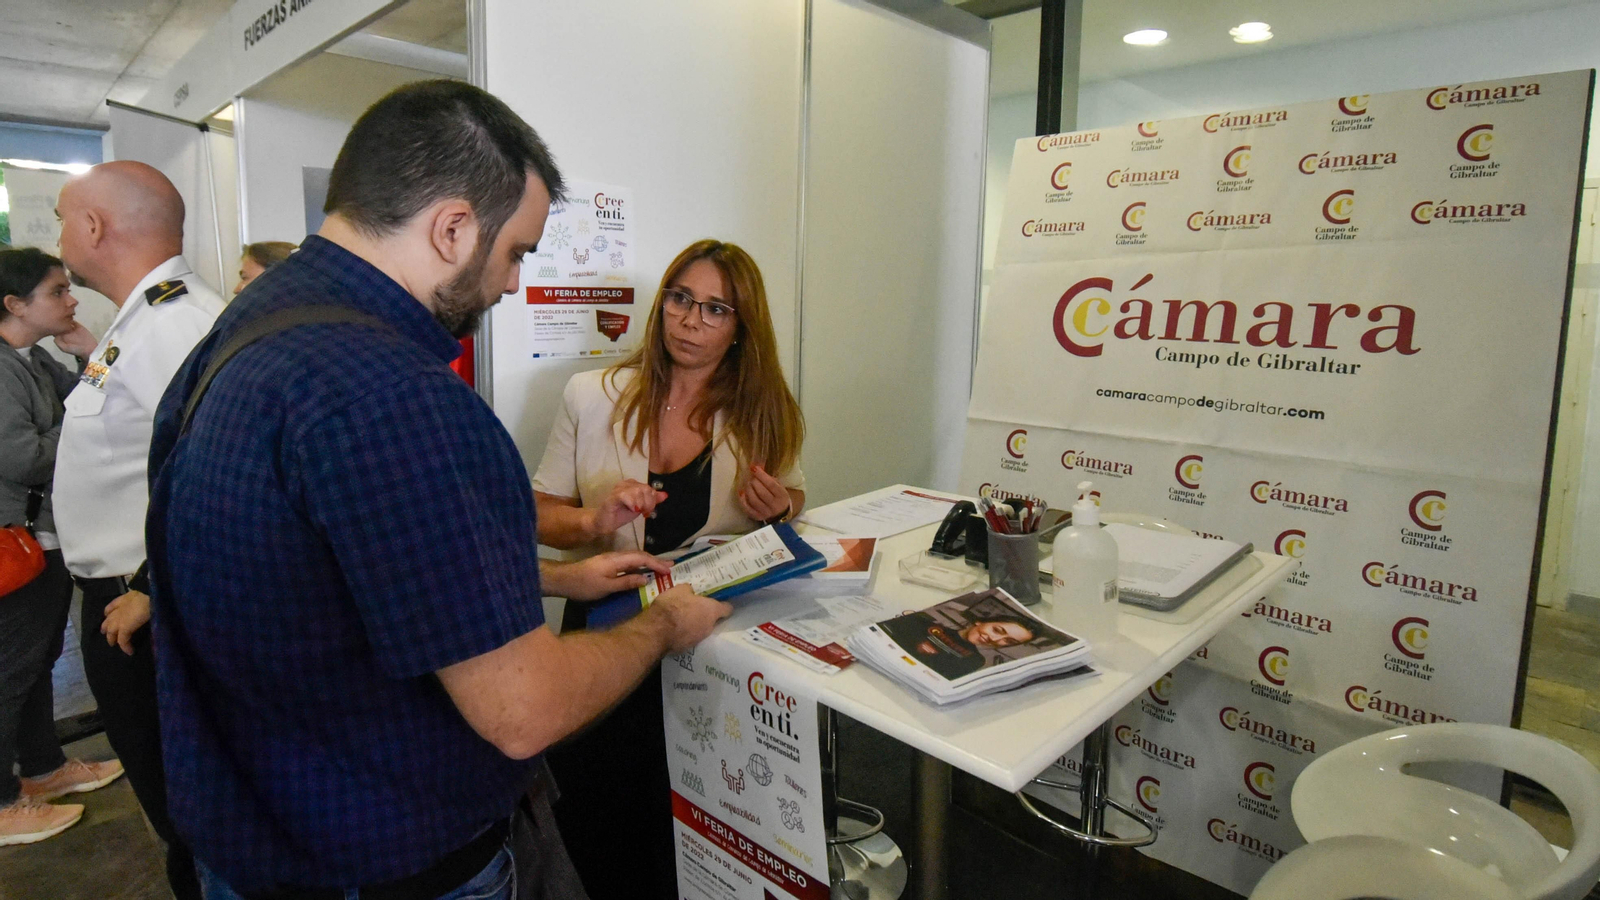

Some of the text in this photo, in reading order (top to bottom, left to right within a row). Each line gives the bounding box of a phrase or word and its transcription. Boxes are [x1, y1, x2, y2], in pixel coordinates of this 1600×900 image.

[244, 0, 287, 51] FUERZAS
[1426, 83, 1541, 110] Cámara
[1203, 110, 1288, 133] Cámara
[1331, 118, 1362, 126] Campo
[1331, 123, 1373, 132] Gibraltar
[1037, 132, 1100, 152] Cámara
[1298, 151, 1397, 175] Cámara
[1449, 164, 1485, 172] Campo
[1106, 167, 1180, 188] Cámara
[1217, 179, 1243, 187] Campo
[1449, 170, 1498, 179] Gibraltar
[1217, 185, 1252, 193] Gibraltar
[596, 210, 610, 219] en
[1187, 209, 1271, 232] Cámara
[1411, 199, 1527, 225] Cámara
[1022, 218, 1085, 237] Cámara
[1315, 226, 1346, 234] Campo
[1315, 232, 1356, 240] Gibraltar
[1052, 273, 1422, 358] Cámara
[1155, 345, 1361, 376] Campo de Gibraltar
[1096, 387, 1325, 420] camaracampodegibraltar.com
[1061, 450, 1133, 476] Cámara
[1168, 487, 1195, 498] Campo
[1168, 494, 1205, 506] Gibraltar
[1250, 480, 1349, 512] Cámara
[1401, 527, 1452, 544] Campo de
[1401, 536, 1450, 551] Gibraltar
[1300, 571, 1310, 579] de
[1362, 561, 1478, 602] Cámara
[1241, 596, 1332, 633] ámara
[1384, 653, 1435, 673] Campo de
[1384, 661, 1432, 681] Gibraltar
[748, 671, 797, 713] Cree
[1250, 679, 1293, 698] Campo de
[1251, 687, 1291, 705] Gibraltar
[1345, 685, 1458, 724] Cámar
[750, 704, 775, 731] en
[754, 724, 766, 737] Ven
[770, 734, 800, 755] encuentra
[1219, 706, 1316, 754] Cámara
[756, 736, 800, 763] tu oportunidad
[1114, 725, 1196, 769] Cámara
[1237, 792, 1280, 813] Campo de
[1238, 801, 1278, 820] Gibraltar
[681, 839, 704, 861] DE 2022
[691, 807, 702, 822] VI
[704, 815, 736, 845] FERIA
[738, 833, 754, 856] DE
[757, 848, 807, 888] EMPLEO
[714, 854, 722, 864] 29
[722, 860, 731, 871] DE
[733, 866, 752, 885] JUNIO
